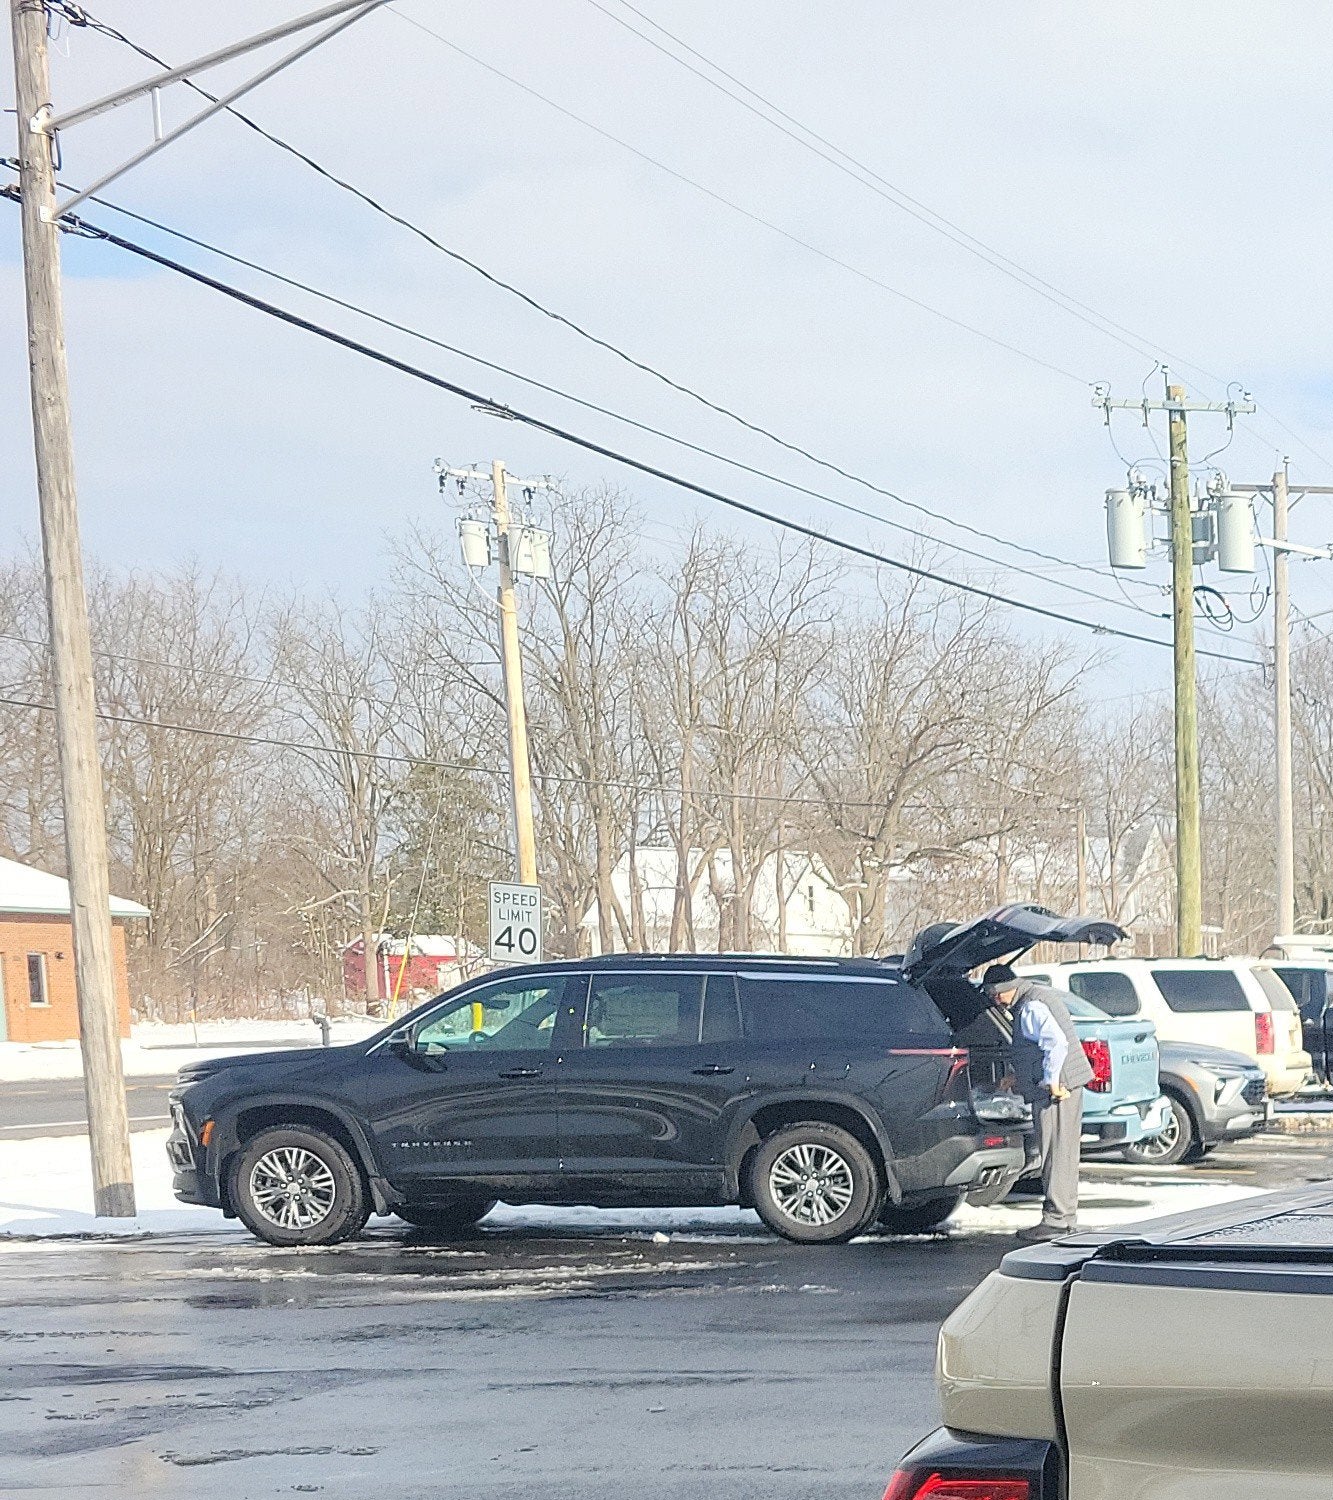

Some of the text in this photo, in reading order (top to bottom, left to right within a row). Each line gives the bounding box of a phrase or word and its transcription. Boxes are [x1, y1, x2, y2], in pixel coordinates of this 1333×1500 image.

[493, 891, 537, 907] SPEED
[498, 908, 532, 923] LIMIT
[494, 925, 537, 955] 40
